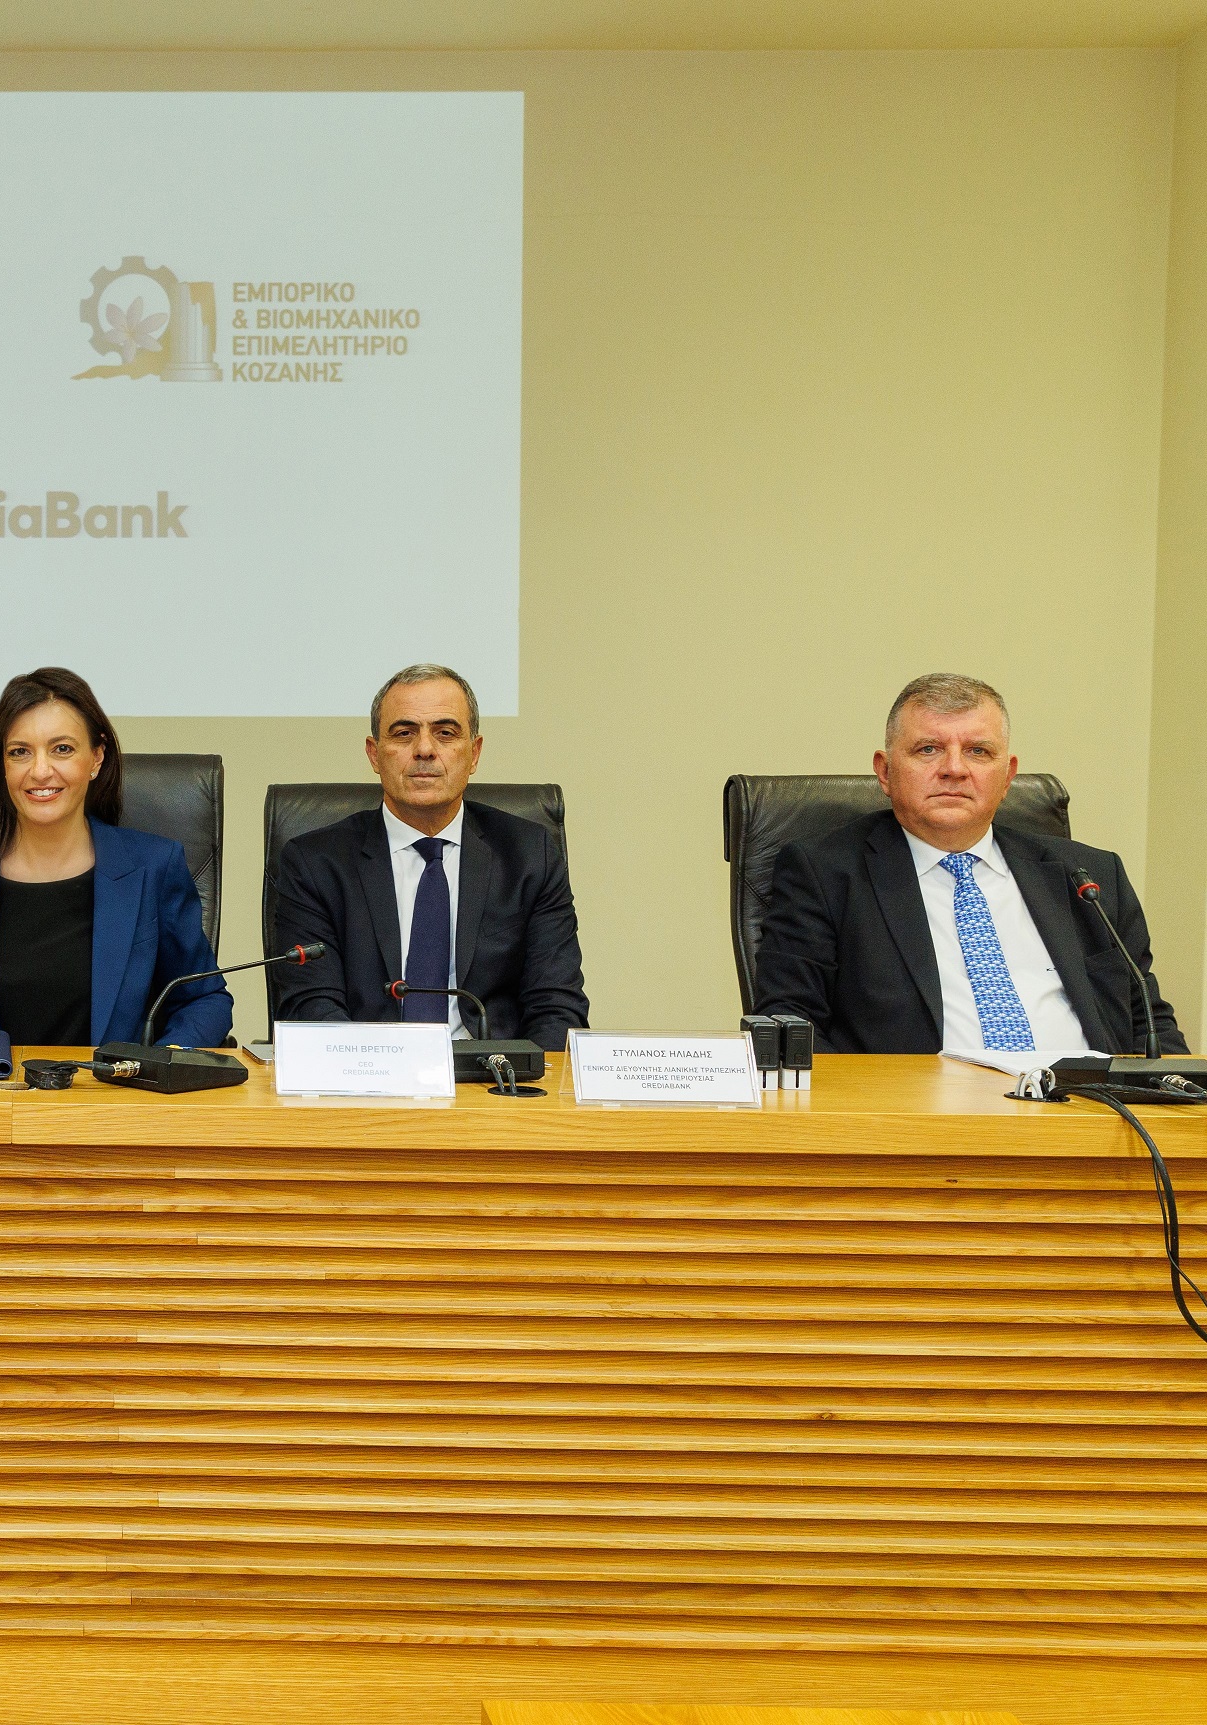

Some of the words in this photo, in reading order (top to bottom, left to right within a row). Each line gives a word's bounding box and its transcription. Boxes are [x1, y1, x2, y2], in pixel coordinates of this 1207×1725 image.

[232, 282, 356, 303] ΕΜΠΟΡΙΚΟ
[231, 308, 248, 329] &
[256, 308, 421, 330] ΒΙΟΜΗΧΑΝΙΚΟ
[232, 335, 409, 356] ΕΠΙΜΕΛΗΤΗΡΙΟ
[232, 362, 343, 383] ΚΟΖΑΝΗΣ
[326, 1044, 358, 1053] ΕΛΕΝΗ
[360, 1045, 405, 1054] ΒΡΕΤΤΟΥ
[612, 1049, 667, 1058] ΣΤΥΛΙΑΝΟΣ
[669, 1050, 713, 1059] ΗΛΙΑΔΗΣ
[342, 1068, 391, 1076] CREDIABANK
[615, 1065, 663, 1073] ΔΙΕΥΘΥΝΤΗΣ
[663, 1066, 699, 1074] ΛΙΑΝΙΚΗΣ
[700, 1067, 747, 1075] ΤΡΑΠΕΖΙΚΗΣ
[623, 1074, 669, 1082] ΔΙΑΧΕΙΡΙΣΗΣ
[670, 1074, 715, 1082] ΠΕΡΙΟΥΣΙΑΣ
[641, 1082, 692, 1090] CREDIABANK
